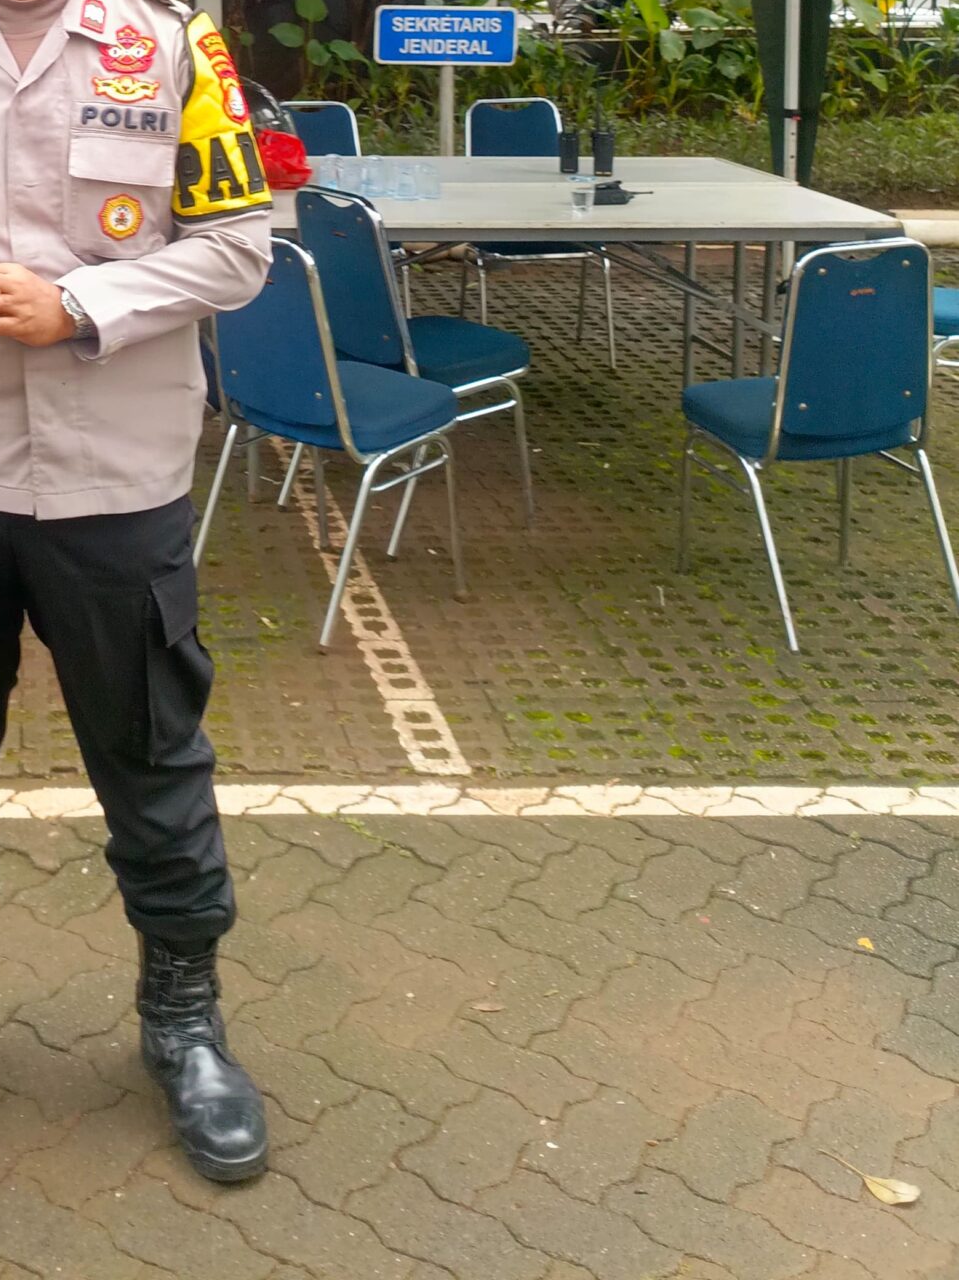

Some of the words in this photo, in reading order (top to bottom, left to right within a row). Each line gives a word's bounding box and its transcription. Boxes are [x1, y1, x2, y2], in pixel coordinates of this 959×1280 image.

[391, 16, 502, 33] SEKRETARIS
[398, 38, 494, 55] JENDERAL
[81, 106, 168, 132] POLRI
